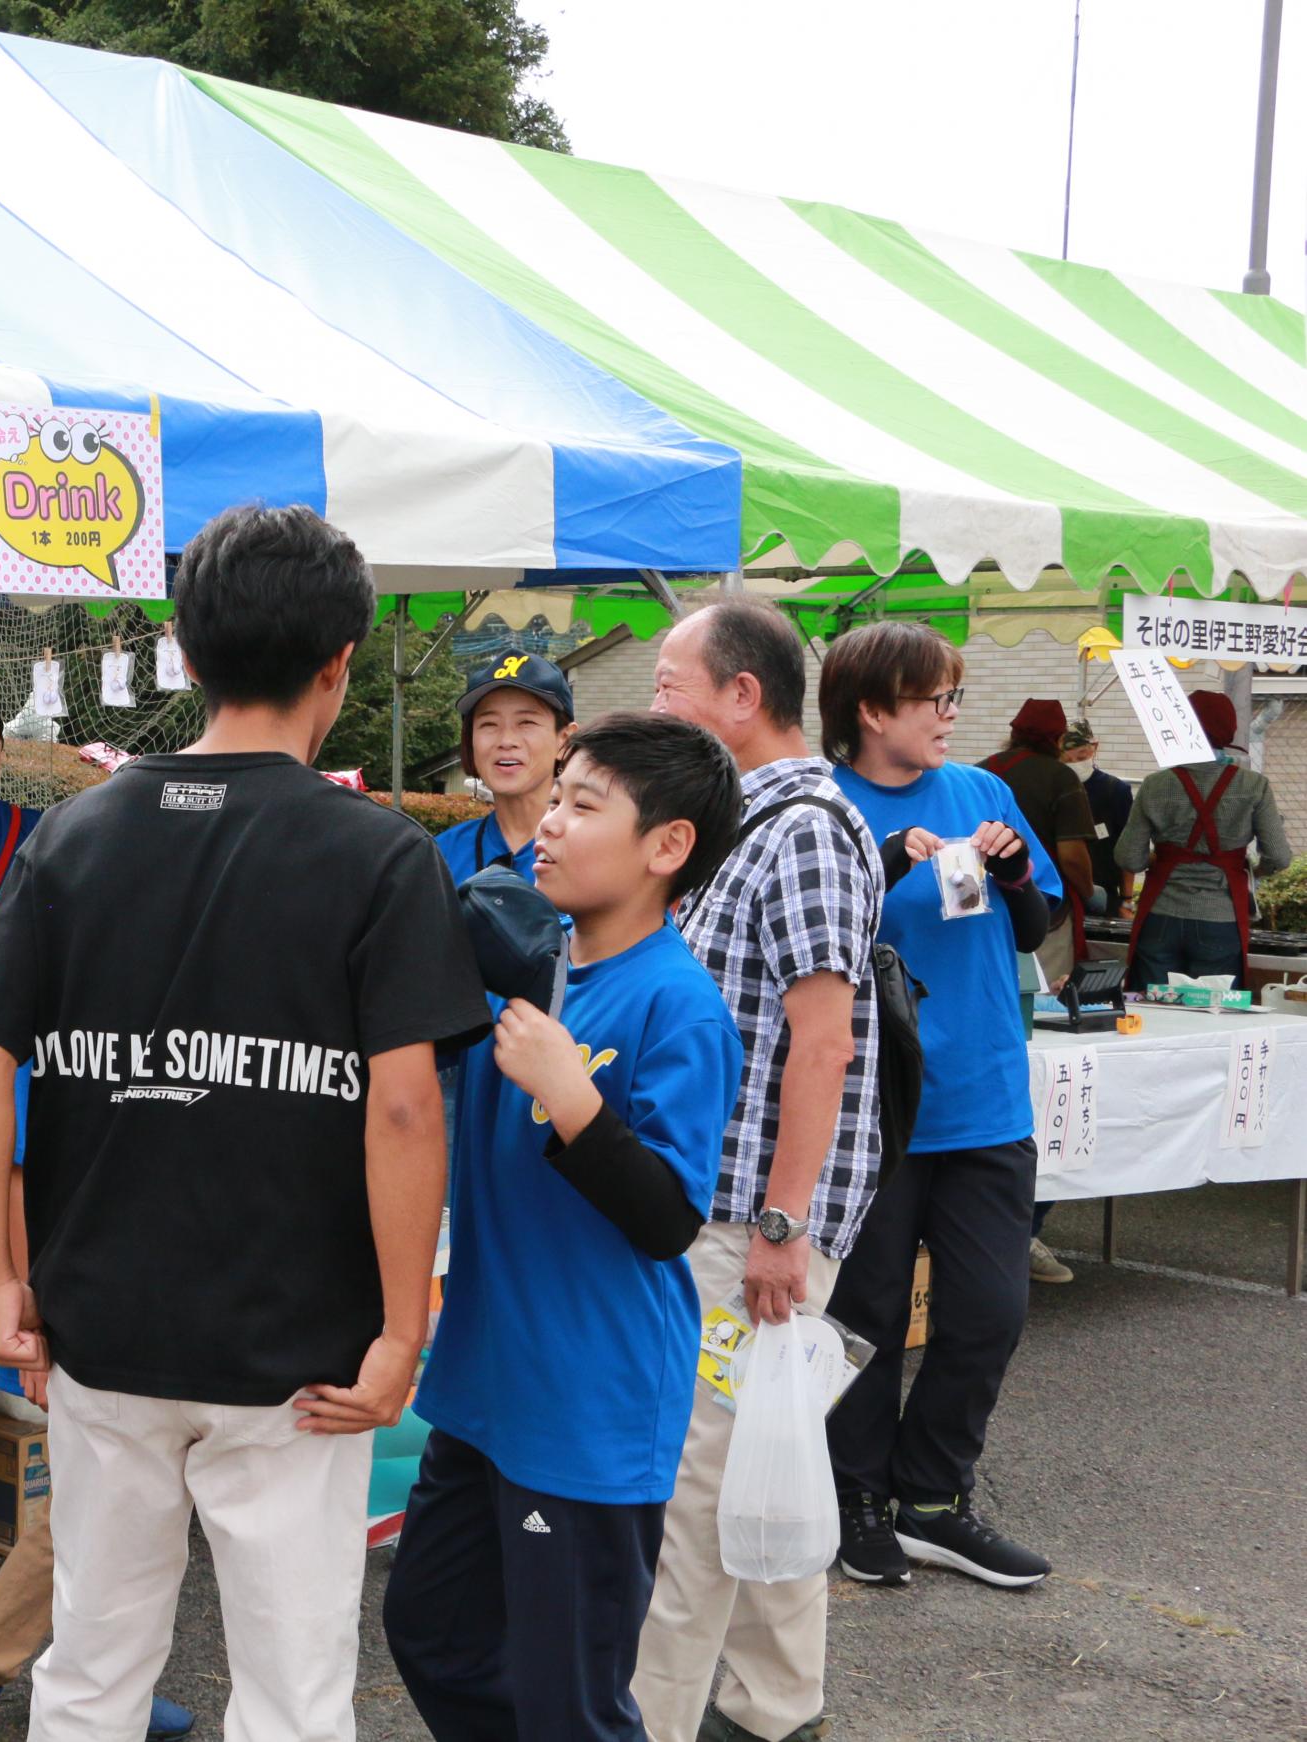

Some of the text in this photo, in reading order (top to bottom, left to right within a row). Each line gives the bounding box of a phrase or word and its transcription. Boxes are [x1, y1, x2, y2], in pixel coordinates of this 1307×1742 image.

[3, 471, 123, 522] Drink
[31, 531, 101, 547] 1本 200円
[165, 1029, 360, 1101] SOMETIMES
[124, 1089, 193, 1102] NDUSTRIES
[1074, 1055, 1095, 1155] 手打ちソバ
[522, 1521, 552, 1533] adidas
